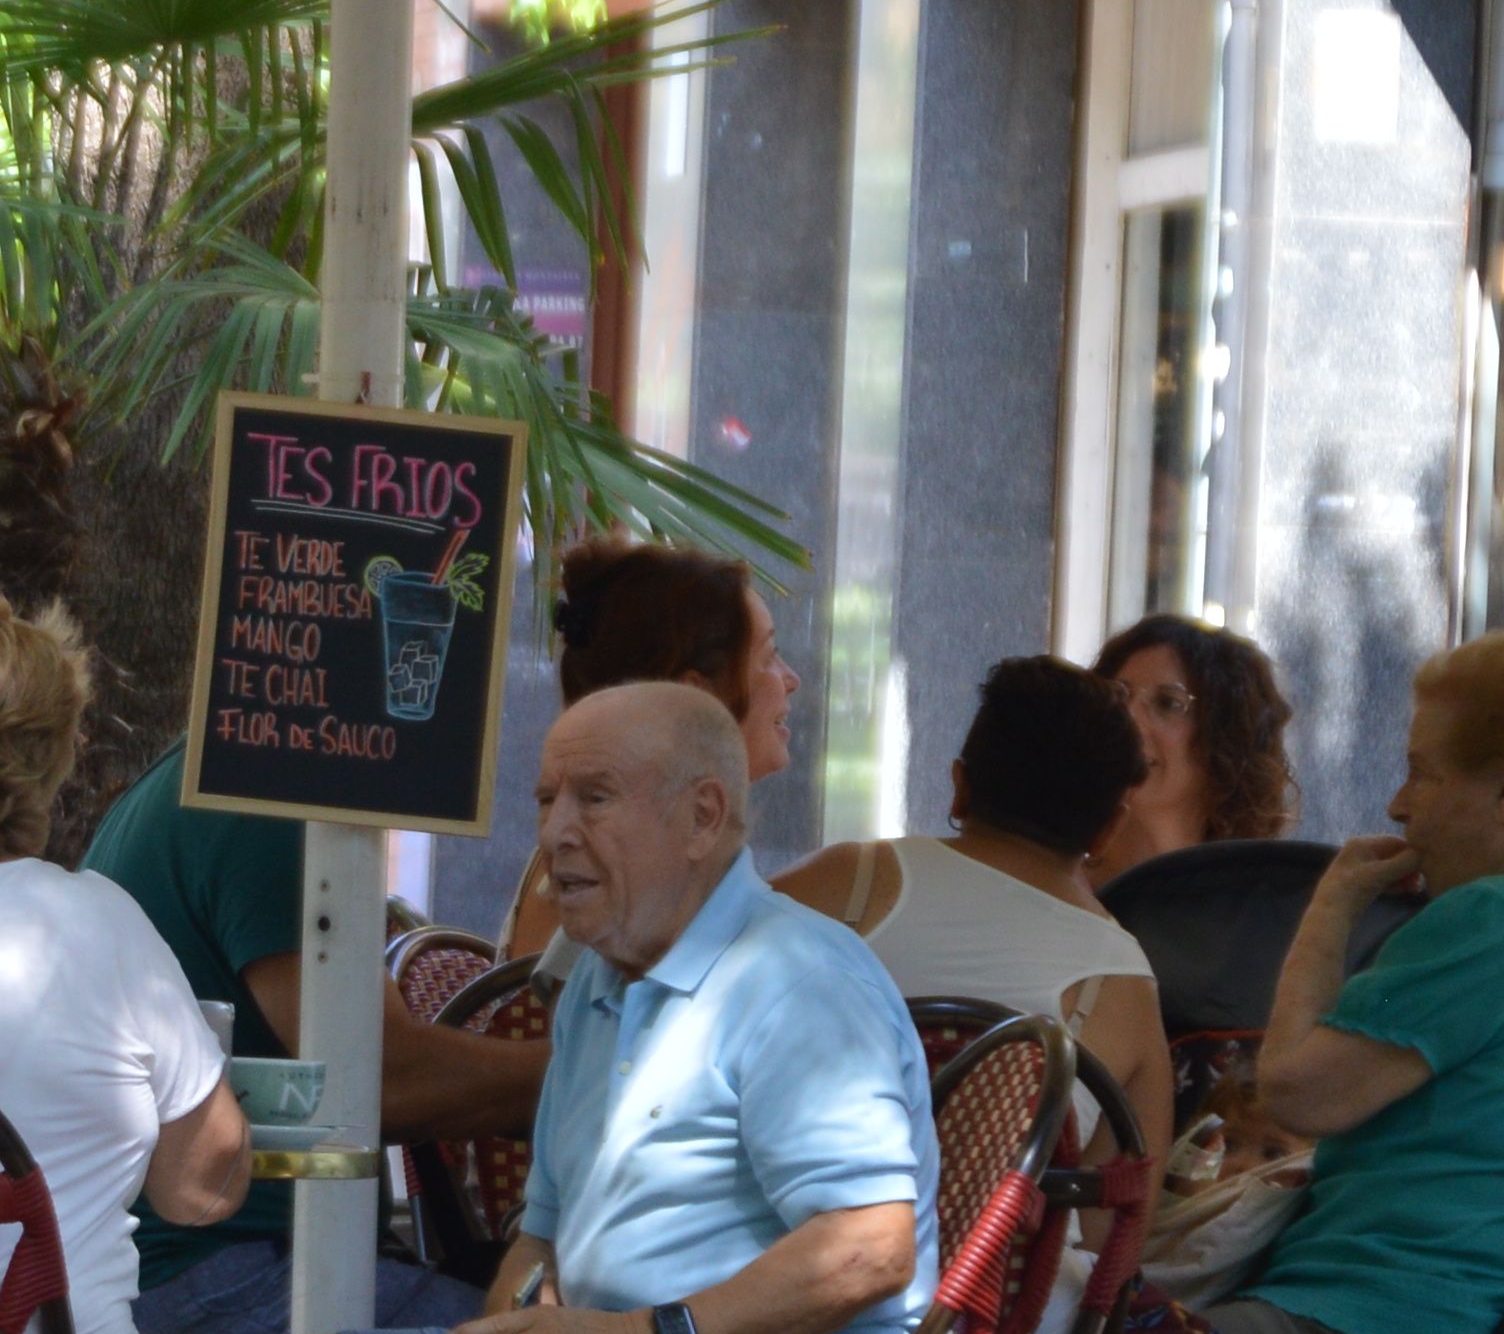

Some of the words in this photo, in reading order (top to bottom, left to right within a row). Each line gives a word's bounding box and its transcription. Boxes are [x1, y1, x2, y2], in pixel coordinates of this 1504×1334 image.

[351, 444, 483, 529] FRIOS
[233, 530, 270, 572] TE
[275, 532, 347, 577] VERDE
[238, 575, 374, 620] FRAMBUESA
[230, 615, 322, 663] MANGO
[221, 658, 260, 700] TE
[264, 663, 332, 709] CHAI
[216, 708, 280, 750] FLOR
[318, 714, 398, 762] SAUCO
